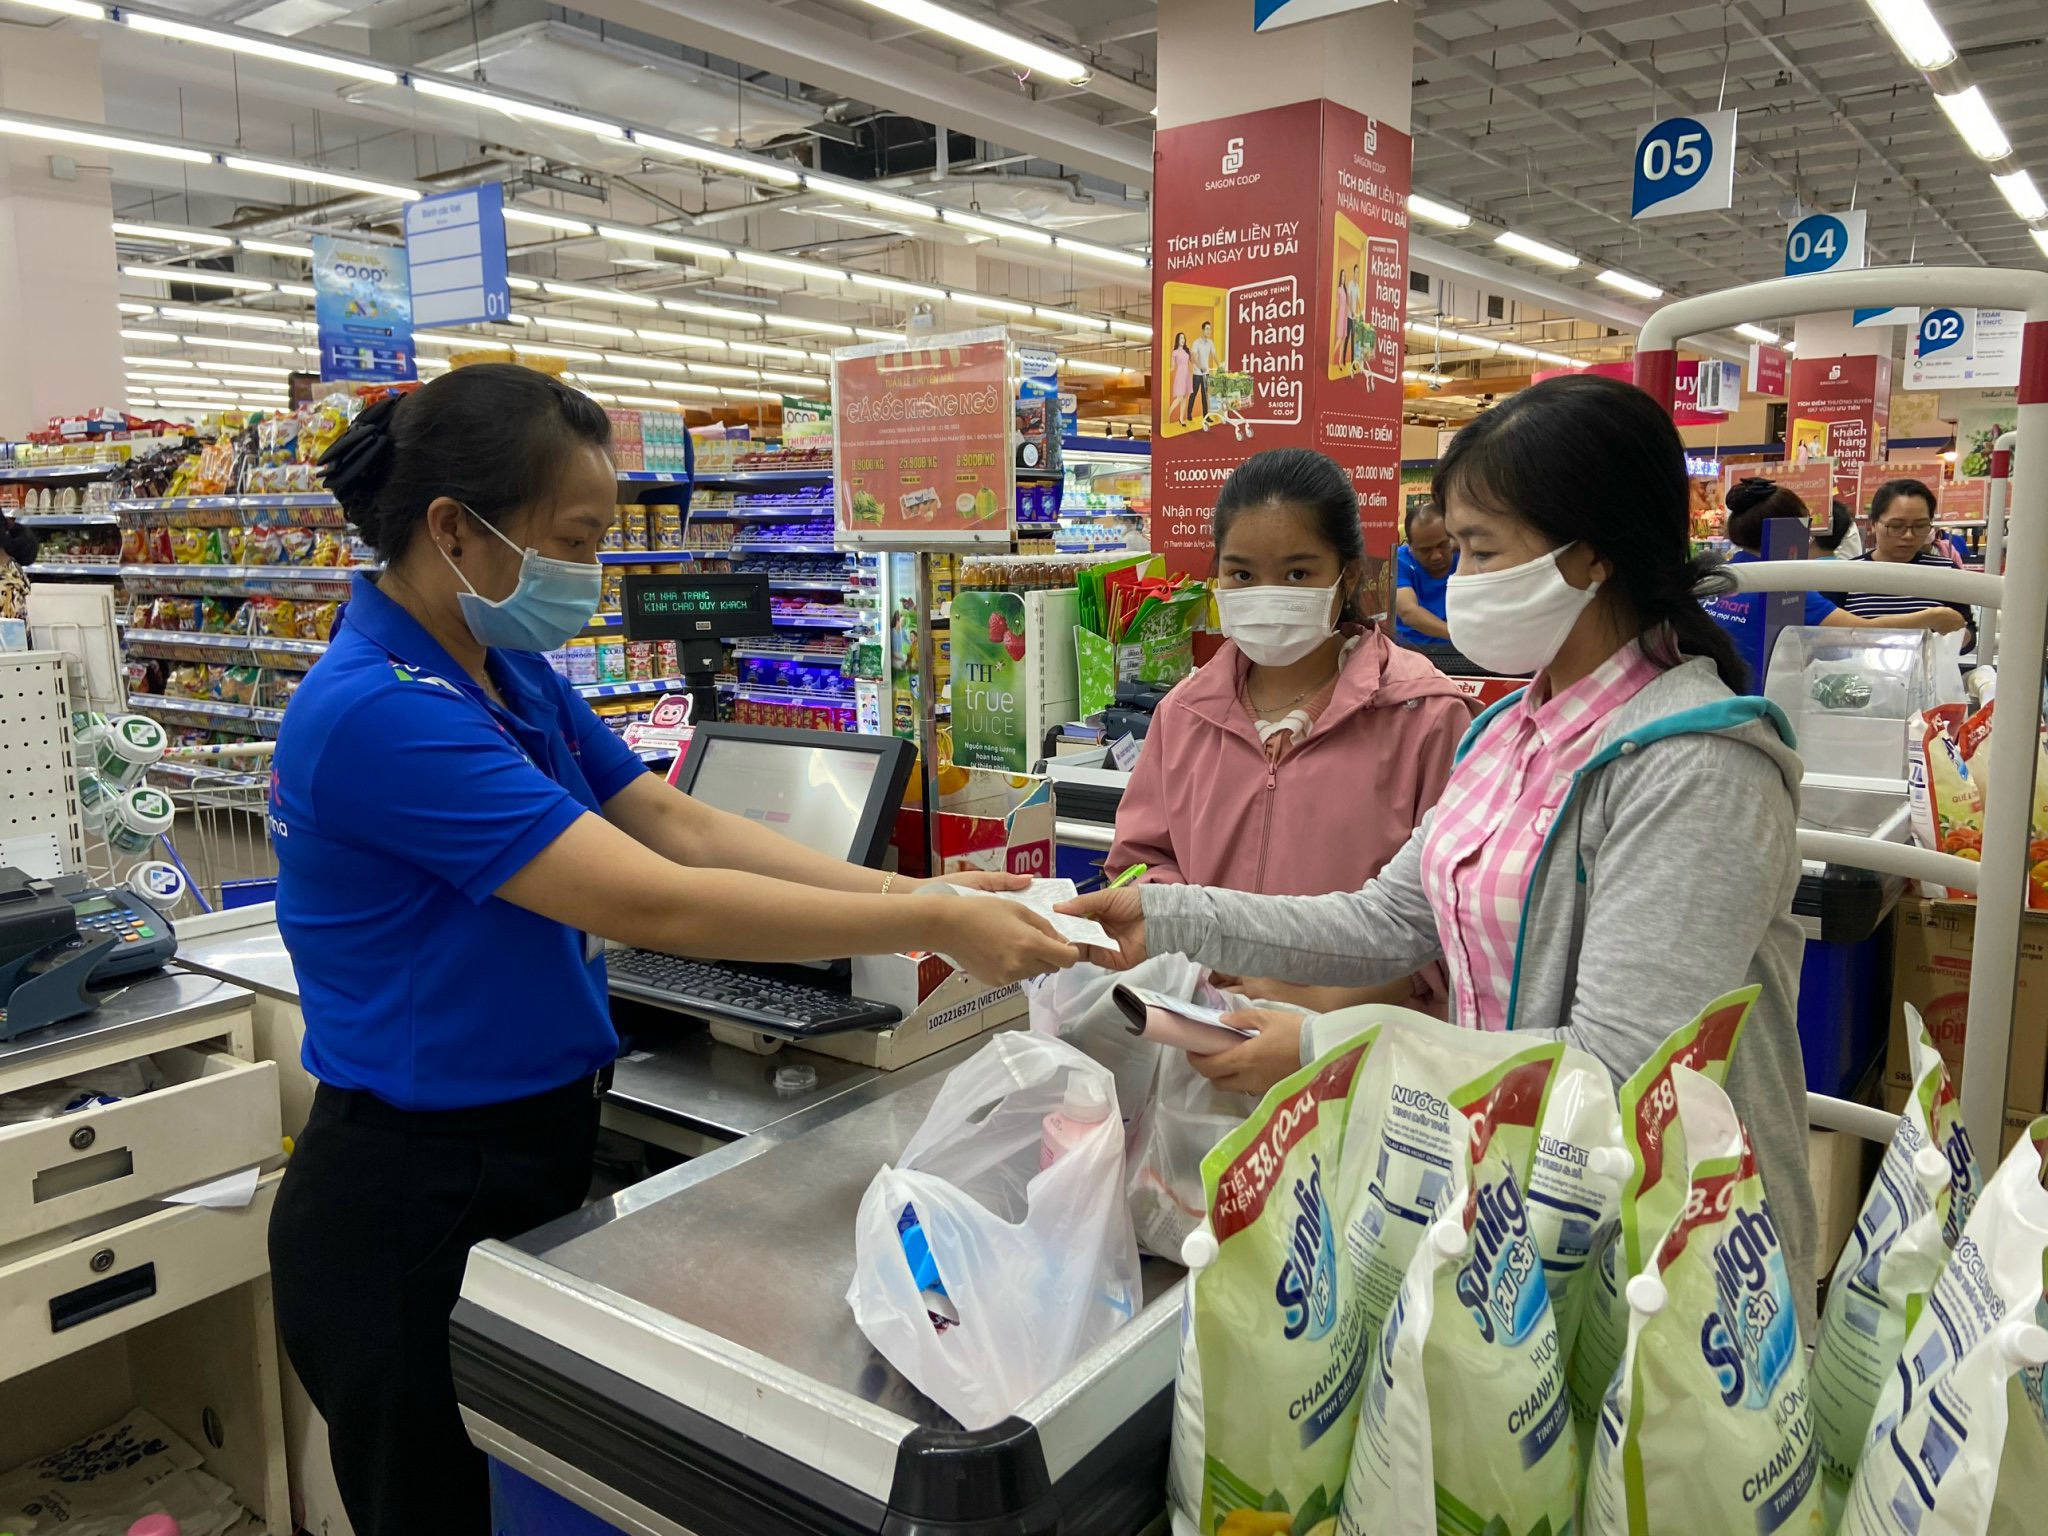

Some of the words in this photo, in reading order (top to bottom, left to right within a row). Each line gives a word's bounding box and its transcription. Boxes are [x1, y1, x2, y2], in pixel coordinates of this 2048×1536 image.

[1353, 154, 1372, 169] SAIGON
[1643, 133, 1702, 181] 05
[1205, 178, 1235, 191] SAIGON
[1338, 168, 1357, 190] TÍCH
[1361, 201, 1380, 219] NGAY
[1382, 208, 1394, 224] ƯU
[1167, 235, 1198, 252] TÍCH
[1202, 226, 1237, 247] ĐIỂM
[1240, 222, 1271, 242] LIỀN
[1274, 221, 1299, 237] TAY
[1789, 228, 1837, 262] 04
[1167, 252, 1204, 270] NHẬN
[1208, 247, 1244, 265] NGAY
[1247, 245, 1270, 259] ƯU
[1273, 237, 1299, 256] ĐÃI
[1371, 255, 1401, 280] khách
[487, 292, 506, 316] 01
[1376, 280, 1400, 309] hàng
[1239, 298, 1305, 324] khách
[1371, 307, 1399, 333] thành
[1250, 323, 1305, 347] hàng
[1924, 317, 1959, 340] 02
[1377, 334, 1399, 358] viên
[1241, 349, 1304, 373] thành
[1257, 376, 1303, 398] viên
[847, 397, 872, 423] GIÁ
[872, 392, 904, 421] SỐC
[905, 391, 959, 419] KHÔNG
[960, 385, 998, 415] NGỜ
[1326, 423, 1347, 438] 10.000
[1348, 424, 1364, 440] VNĐ
[1833, 427, 1867, 438] khách
[1838, 437, 1867, 448] hàng
[1834, 448, 1865, 458] thành
[1174, 469, 1208, 482] 10.000
[1356, 465, 1377, 480] 20.000
[1369, 489, 1387, 507] điểm
[1162, 504, 1193, 520] Nhận
[1171, 521, 1196, 535] cho
[643, 591, 656, 601] CM
[660, 592, 678, 600] NHA
[682, 591, 710, 600] TRANG
[644, 602, 668, 612] KINH
[672, 602, 695, 611] CHAO
[699, 601, 716, 610] QUY
[720, 600, 747, 610] KHACH
[1730, 616, 1747, 624] nhà
[966, 663, 993, 683] TH
[965, 684, 1014, 713] true
[964, 716, 1014, 736] JUICE
[964, 742, 983, 750] Nguồn
[984, 744, 998, 753] năng
[976, 752, 990, 760] hoàn
[928, 1000, 977, 1030] 1022216372
[1391, 1085, 1441, 1116] NƯỚC
[1221, 1167, 1247, 1197] TIẾT
[1220, 1184, 1257, 1217] KIỆM
[1490, 1271, 1518, 1336] Lau
[1507, 1236, 1537, 1285] Sàn
[1289, 1356, 1341, 1421] CHANH
[1317, 1400, 1338, 1425] TINH
[1508, 1371, 1555, 1434] CHANH
[1535, 1418, 1556, 1445] TINH
[1742, 1437, 1797, 1503] CHANH
[1773, 1484, 1795, 1513] TINH
